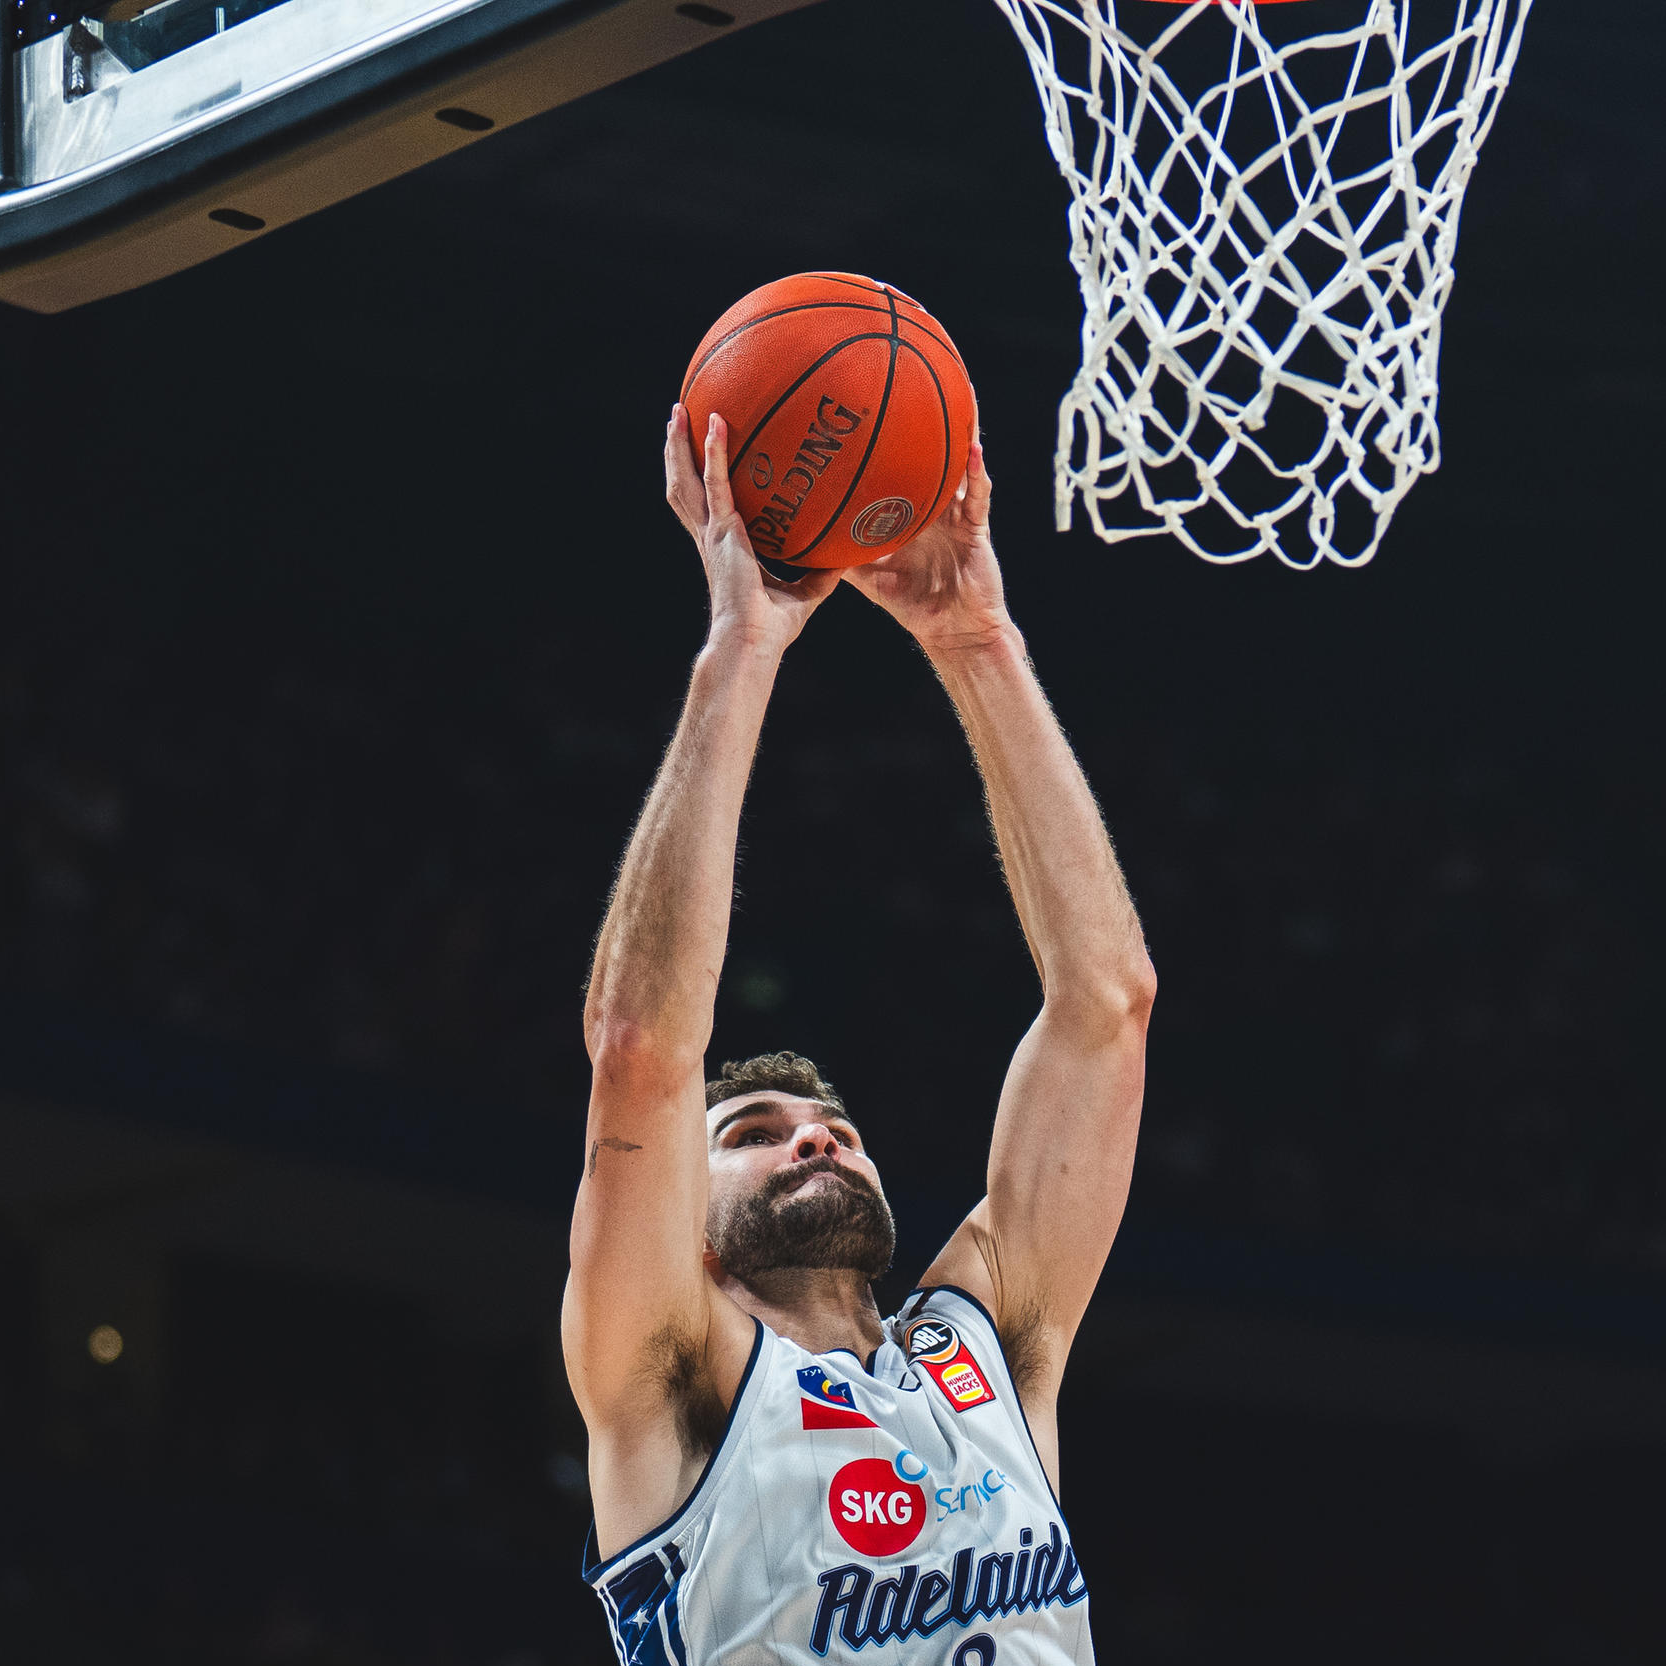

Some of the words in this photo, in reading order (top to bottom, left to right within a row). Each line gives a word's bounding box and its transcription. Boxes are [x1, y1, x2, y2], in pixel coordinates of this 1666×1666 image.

[946, 1371, 974, 1387] HUNGRY
[840, 1489, 913, 1525] SKG
[809, 1521, 1089, 1657] Adelaide
